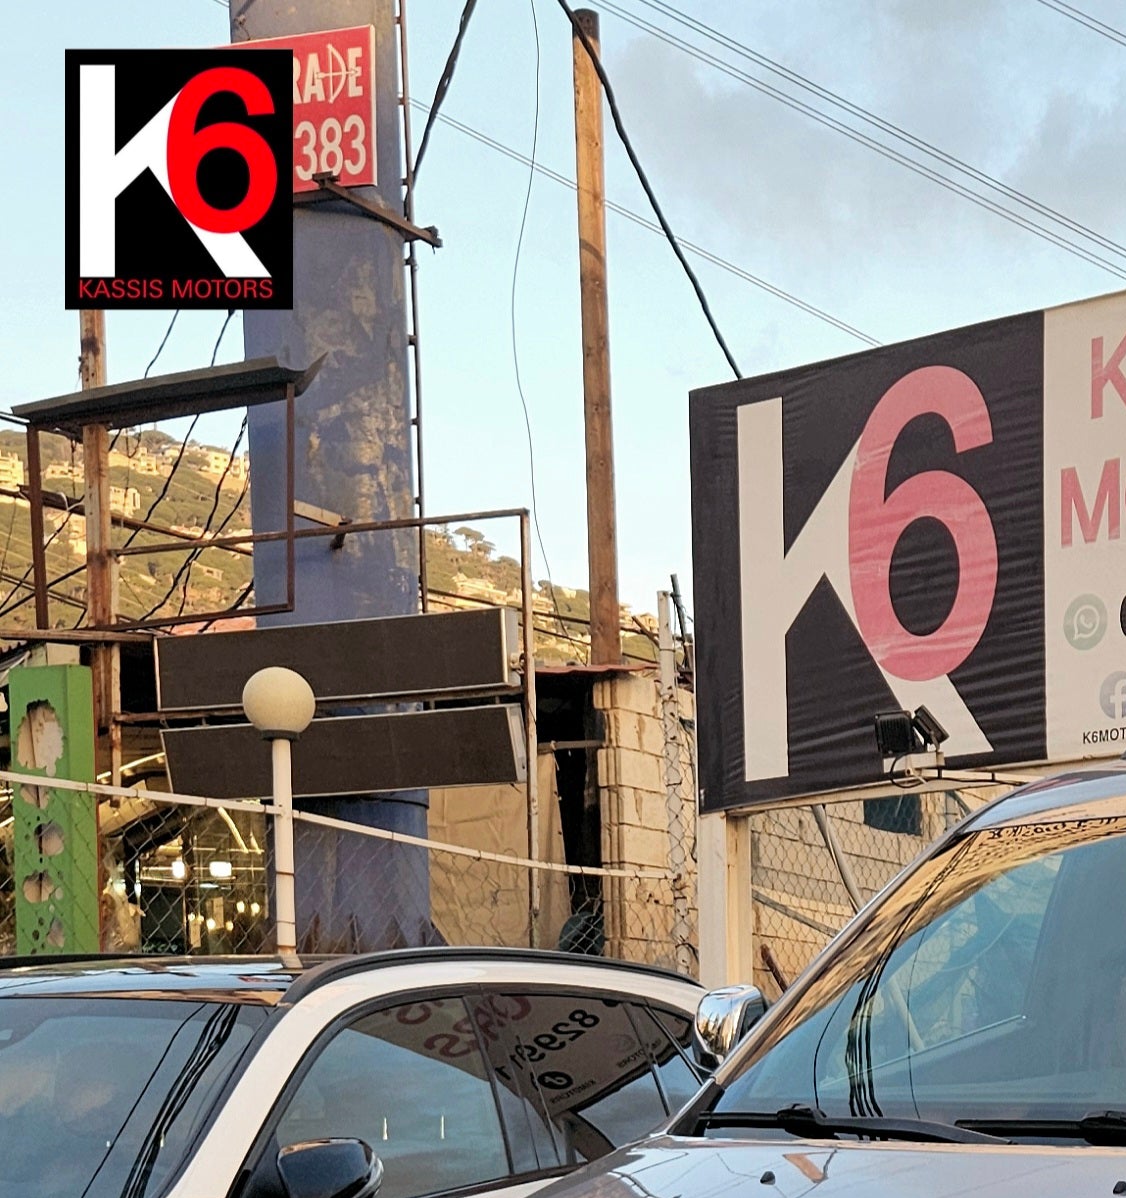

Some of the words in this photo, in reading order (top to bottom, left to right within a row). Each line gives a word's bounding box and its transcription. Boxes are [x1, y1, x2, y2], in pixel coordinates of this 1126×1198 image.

[293, 43, 364, 105] RADE
[294, 114, 367, 181] 383
[737, 365, 998, 782] K6
